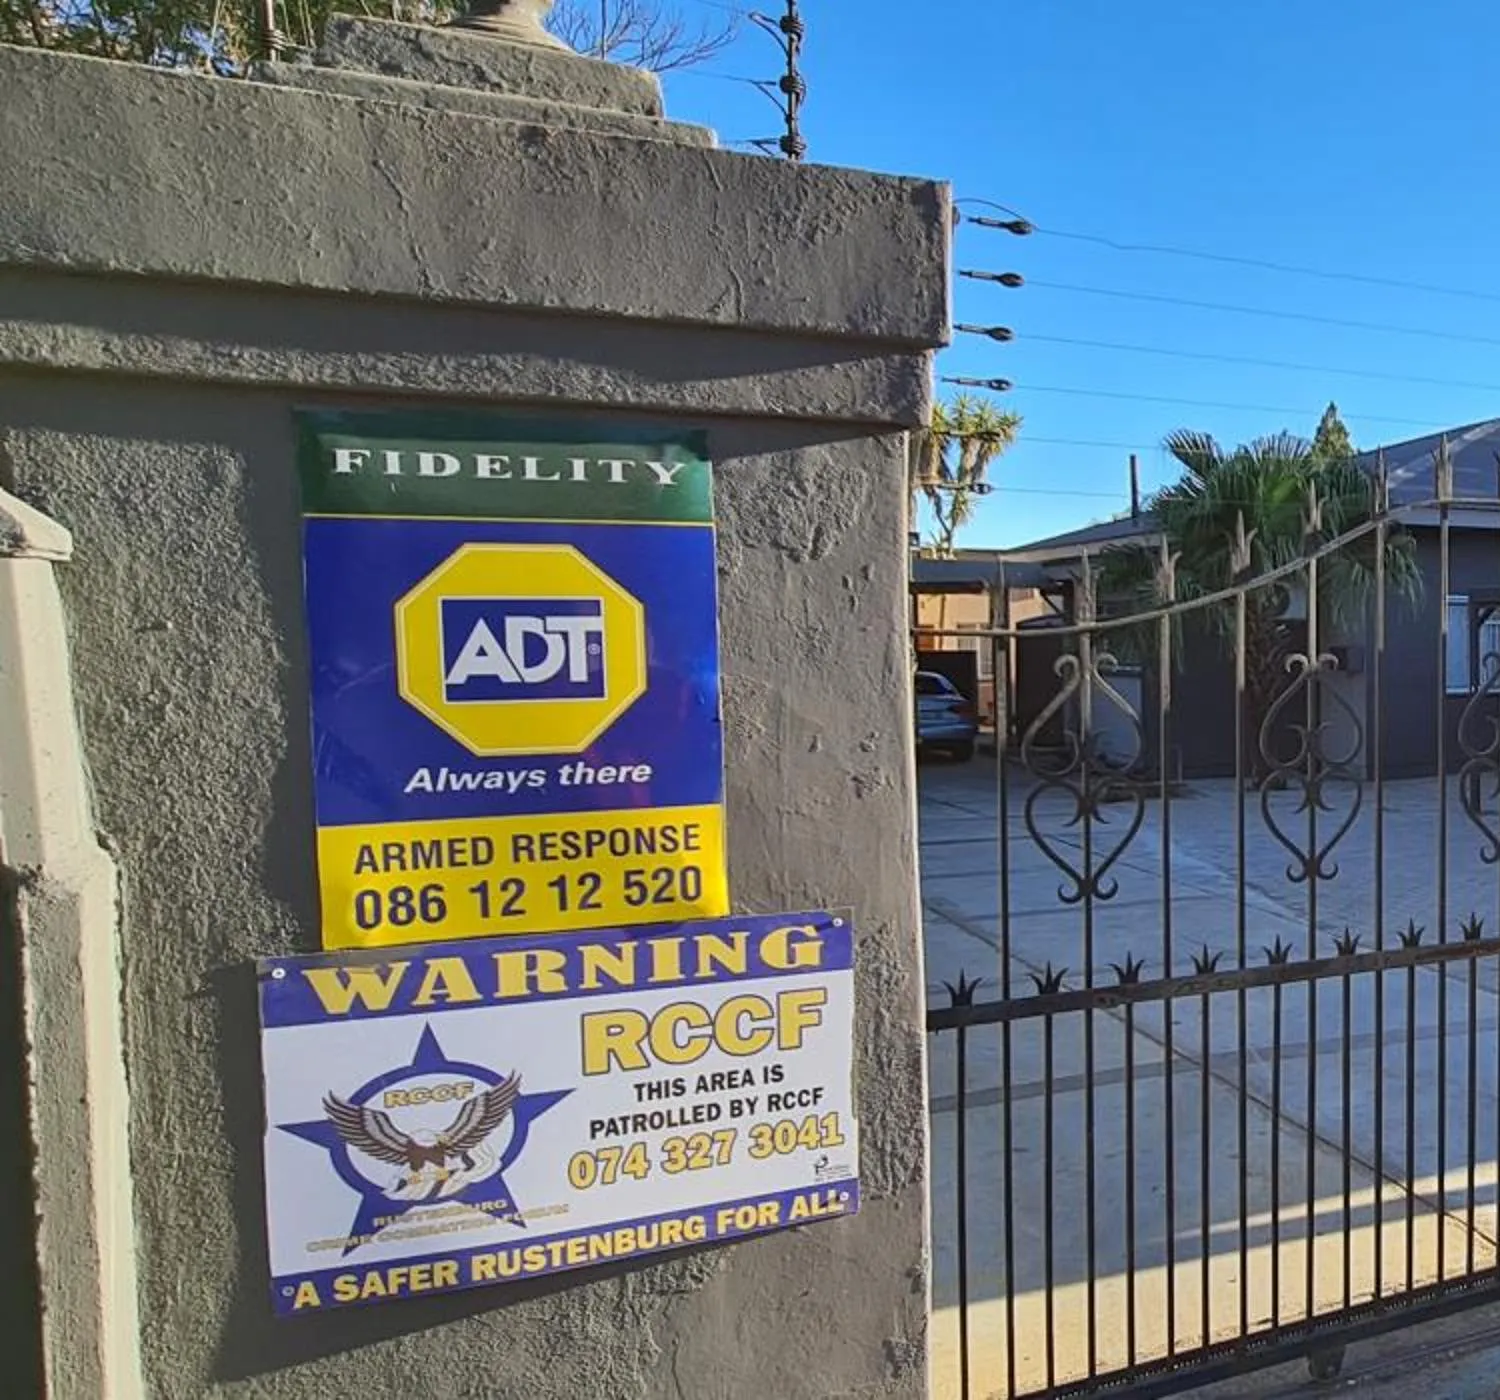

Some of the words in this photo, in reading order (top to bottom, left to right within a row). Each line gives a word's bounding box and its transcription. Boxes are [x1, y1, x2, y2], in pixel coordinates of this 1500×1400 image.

[333, 447, 687, 485] FIDELITY
[446, 616, 602, 684] ADT
[404, 767, 547, 795] Always
[558, 761, 653, 786] there
[354, 835, 495, 875] ARMED
[511, 823, 701, 864] RESPONSE
[354, 883, 448, 930] 086
[468, 878, 527, 919] 12
[547, 871, 603, 912] 12
[623, 864, 703, 907] 520
[301, 925, 825, 1015] WARNING
[580, 986, 828, 1077] RCCF
[589, 1102, 722, 1140] PATROLLED
[729, 1096, 759, 1119] BY
[766, 1086, 825, 1113] RCCF
[634, 1077, 687, 1102] THIS
[695, 1069, 755, 1095] AREA
[763, 1064, 785, 1085] IS
[568, 1141, 650, 1190] 074
[660, 1127, 738, 1174] 327
[747, 1111, 845, 1159] 3041
[294, 1280, 321, 1310] A
[332, 1259, 460, 1302] SAFER
[471, 1215, 707, 1282] RUSTENBURG
[716, 1201, 781, 1236] FOR
[788, 1188, 846, 1222] ALL
